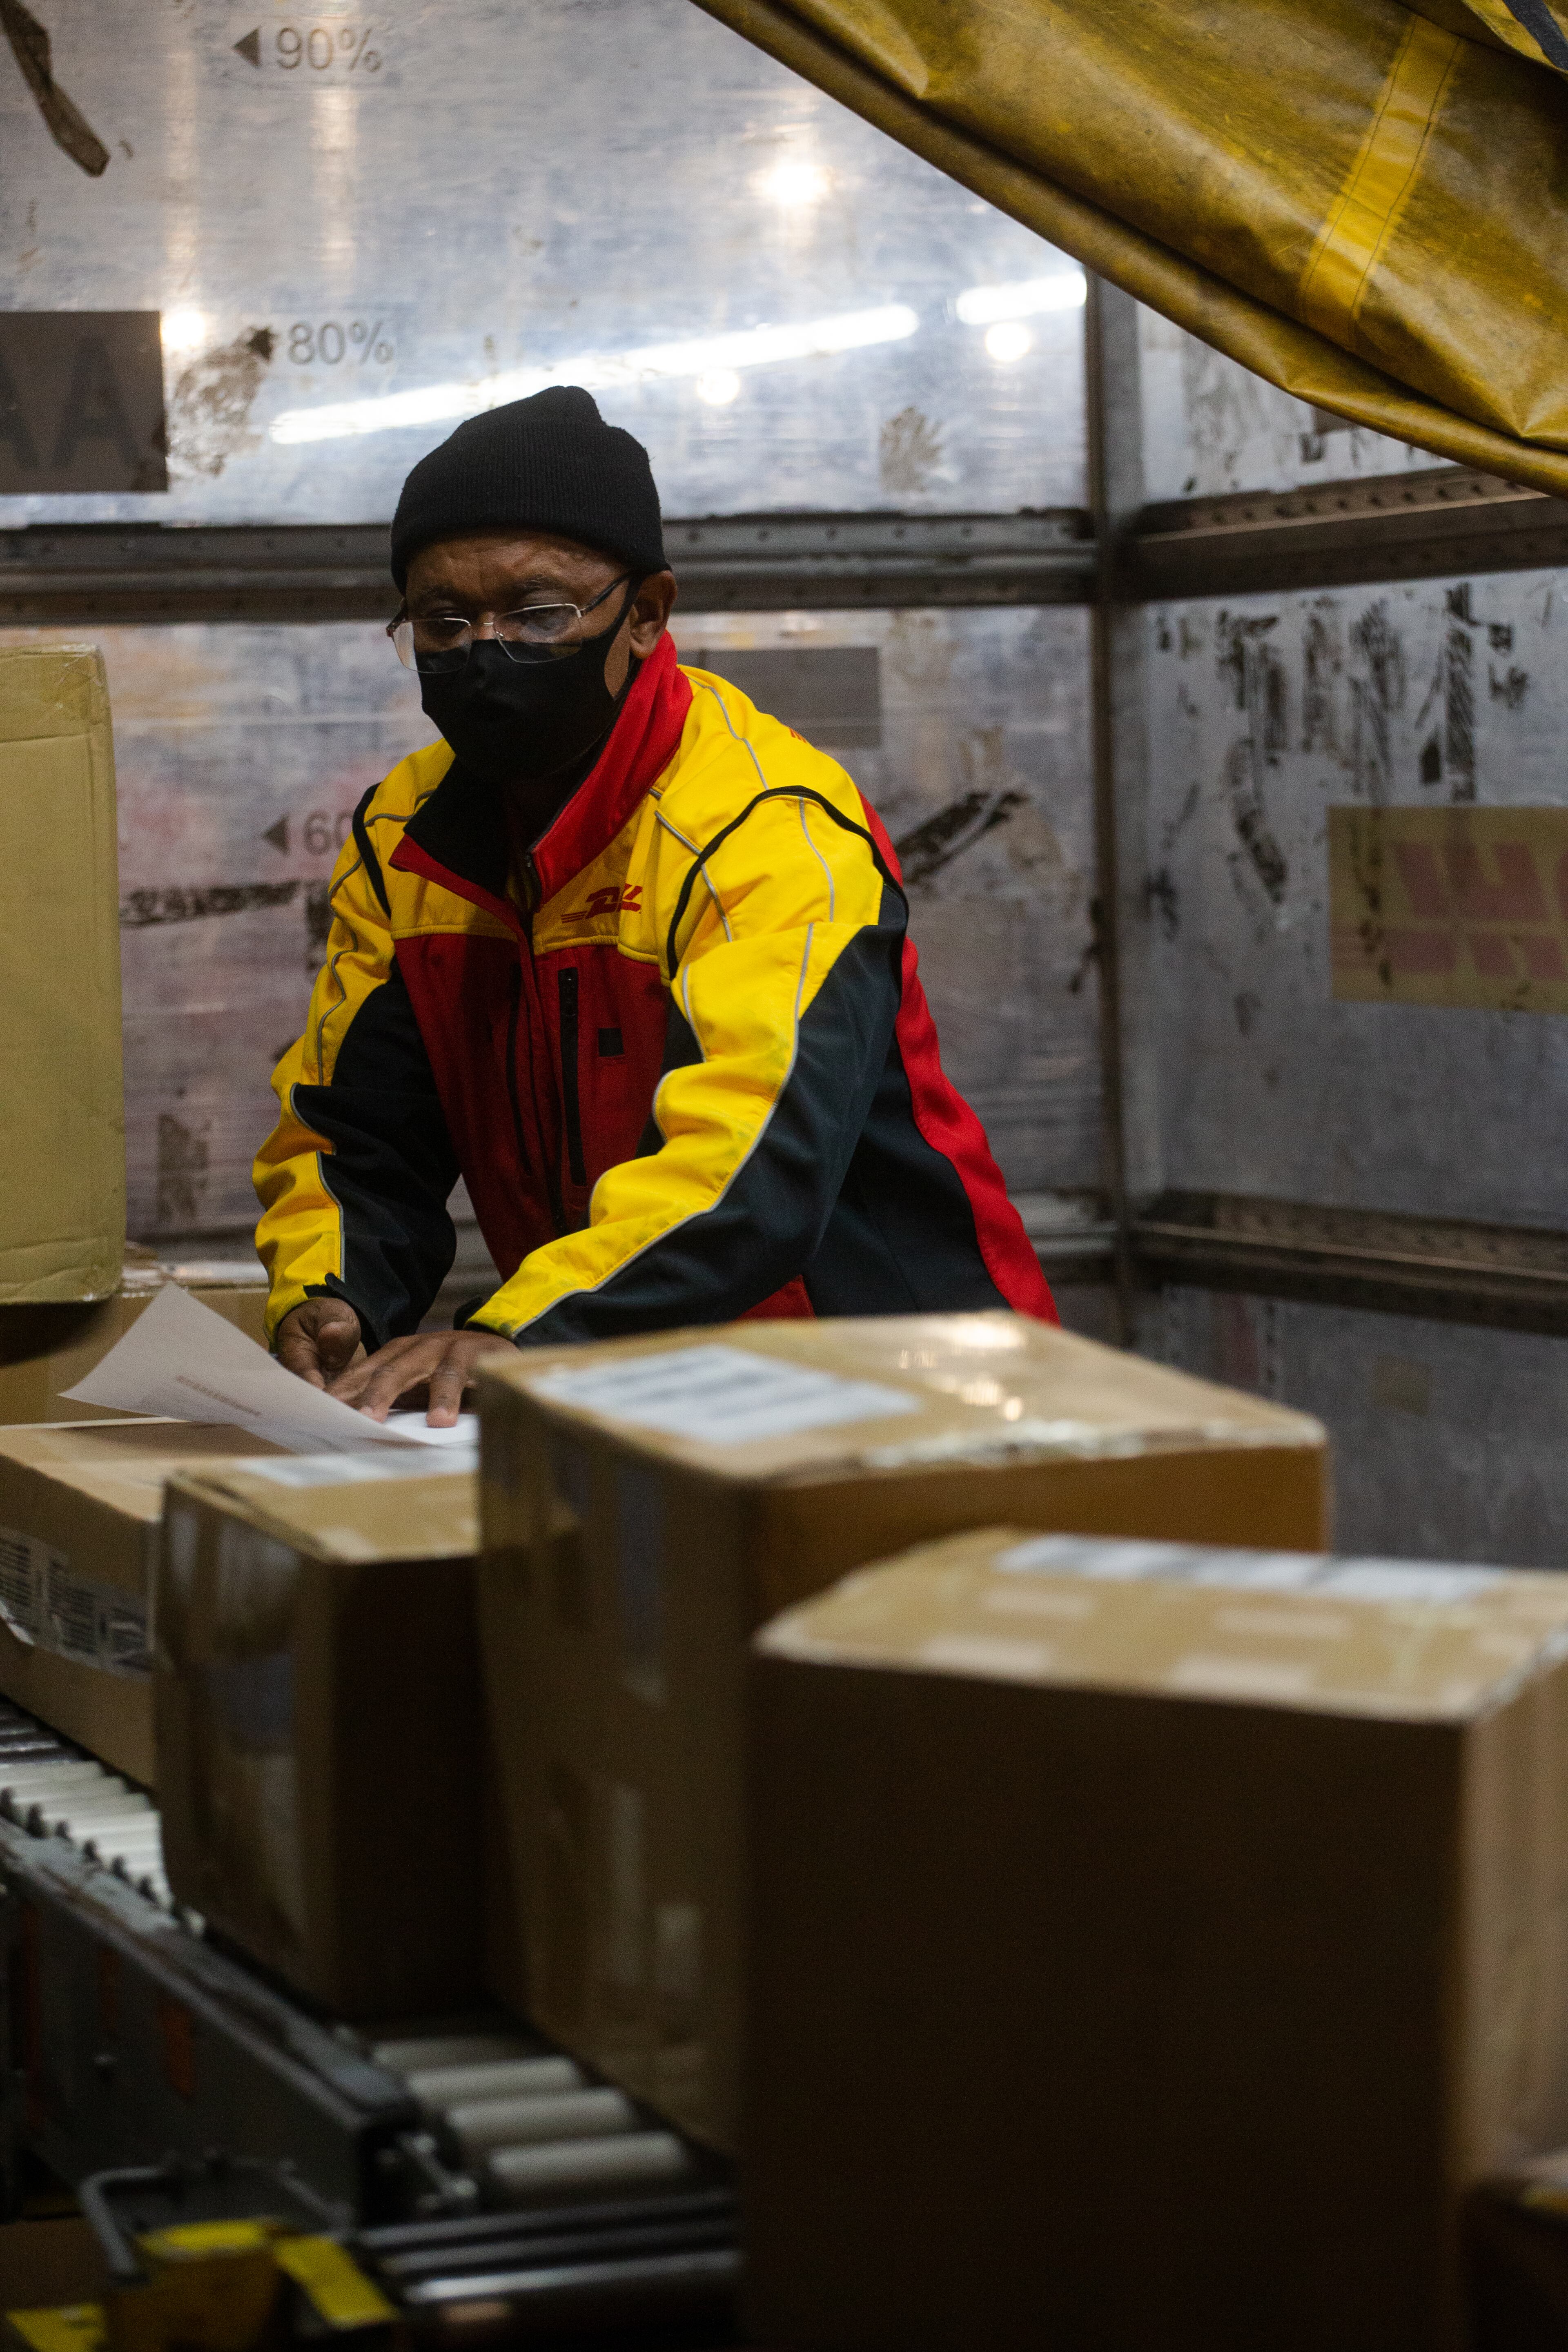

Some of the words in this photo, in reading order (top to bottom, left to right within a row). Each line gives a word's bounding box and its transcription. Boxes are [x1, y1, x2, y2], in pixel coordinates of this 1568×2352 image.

[276, 26, 383, 73] 90%
[287, 321, 394, 366] 80%
[585, 883, 643, 920] DL
